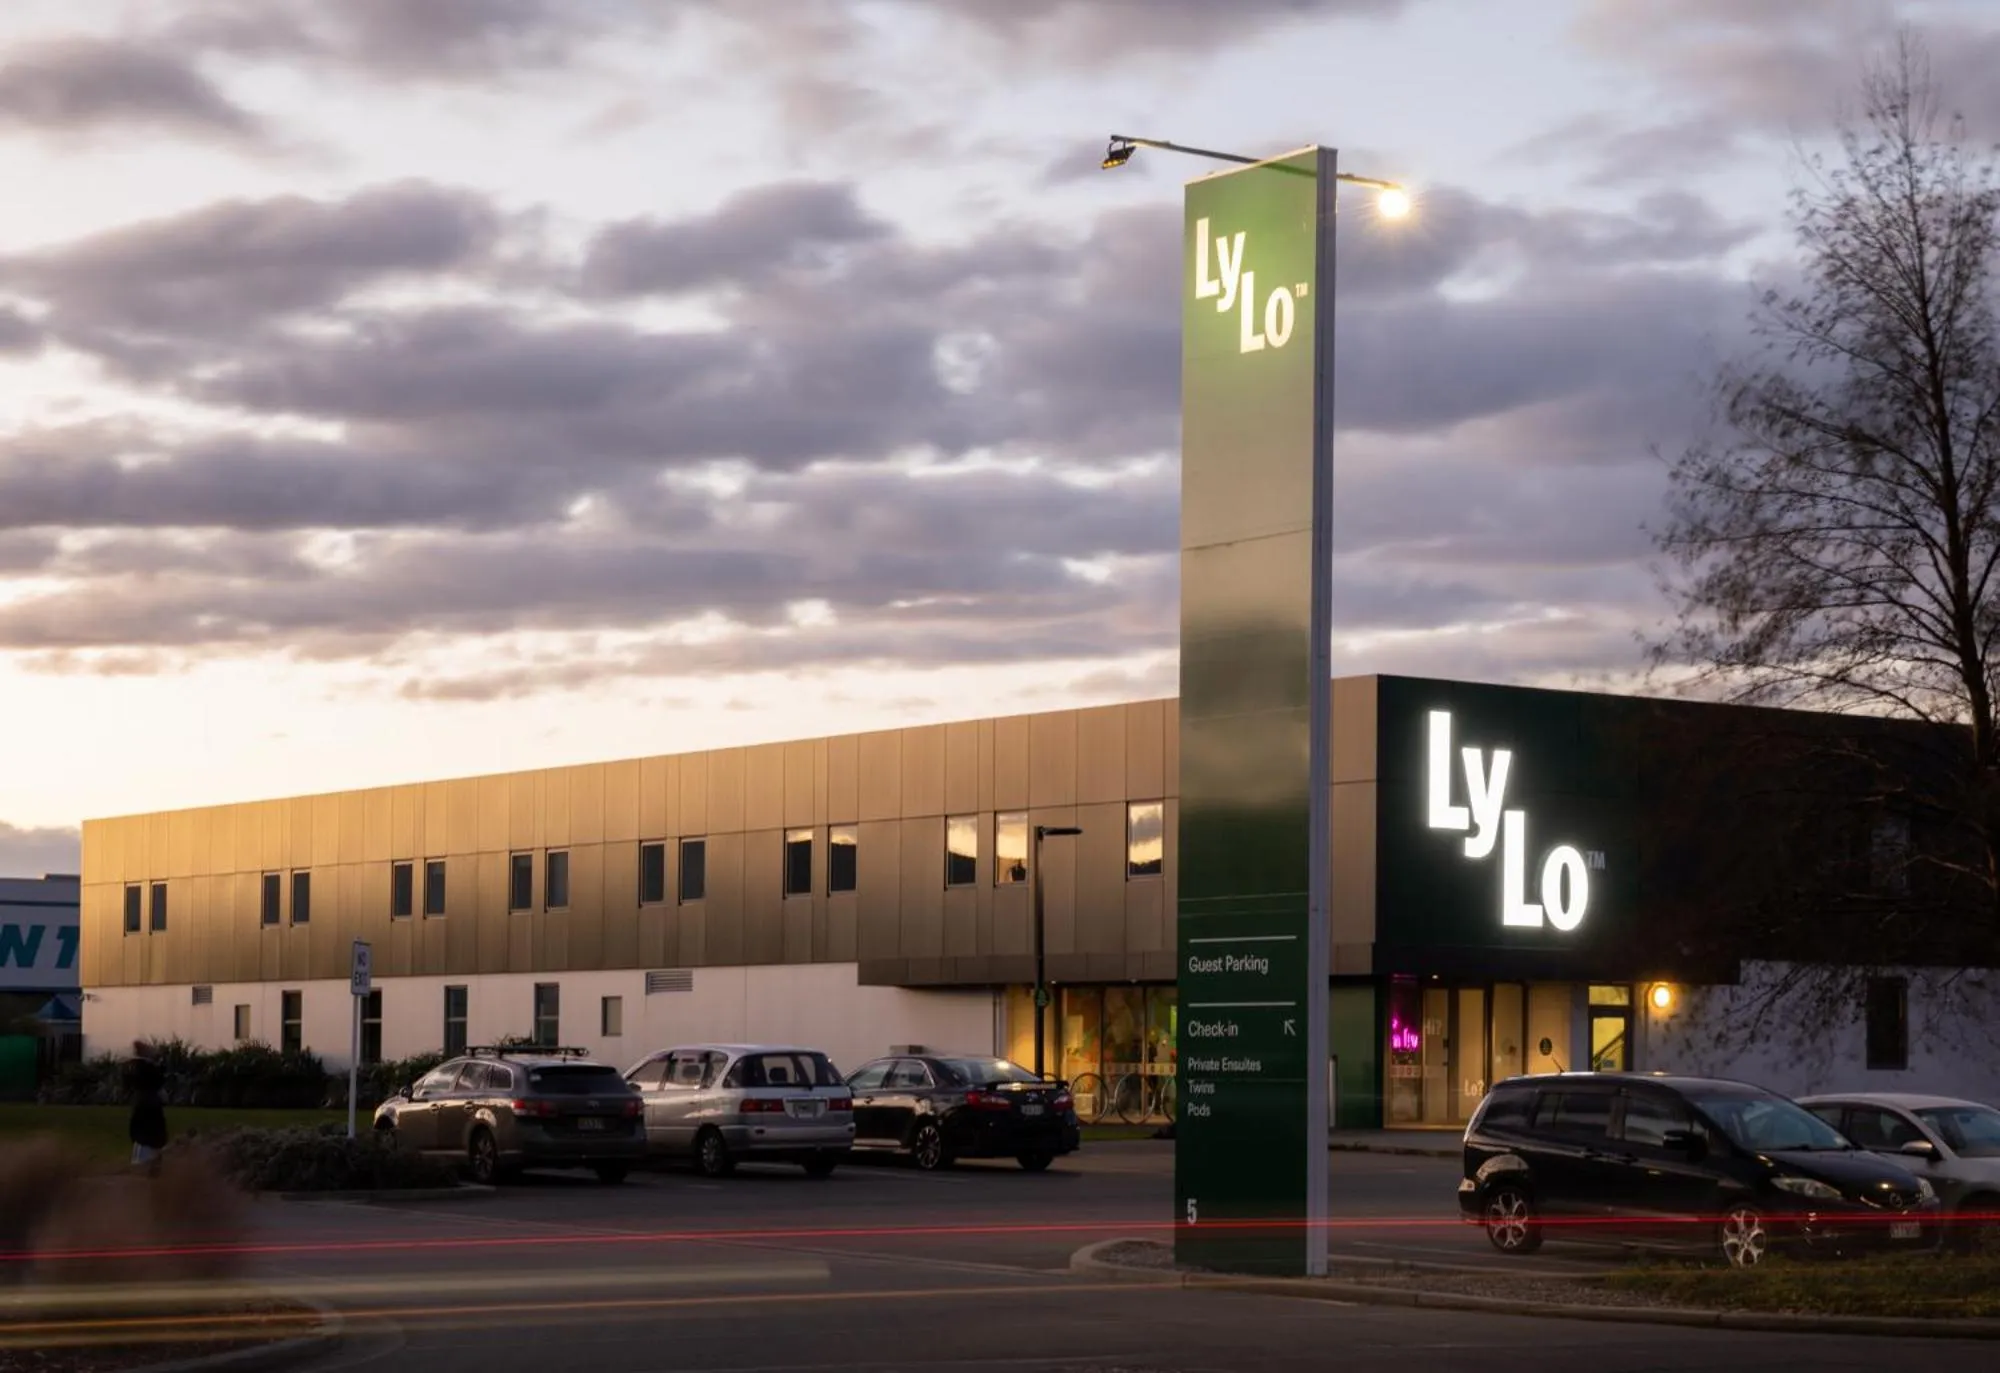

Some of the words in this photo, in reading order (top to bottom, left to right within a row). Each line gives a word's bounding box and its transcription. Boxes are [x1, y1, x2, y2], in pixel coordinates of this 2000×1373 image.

[1188, 956, 1223, 973] Guest
[1226, 955, 1269, 974] Parking
[1188, 1020, 1239, 1037] Check-in
[1187, 1058, 1220, 1072] Private
[1221, 1057, 1262, 1072] Ensuites
[1188, 1080, 1215, 1095] Twins
[1187, 1102, 1211, 1117] Pods
[1187, 1199, 1198, 1225] 5
